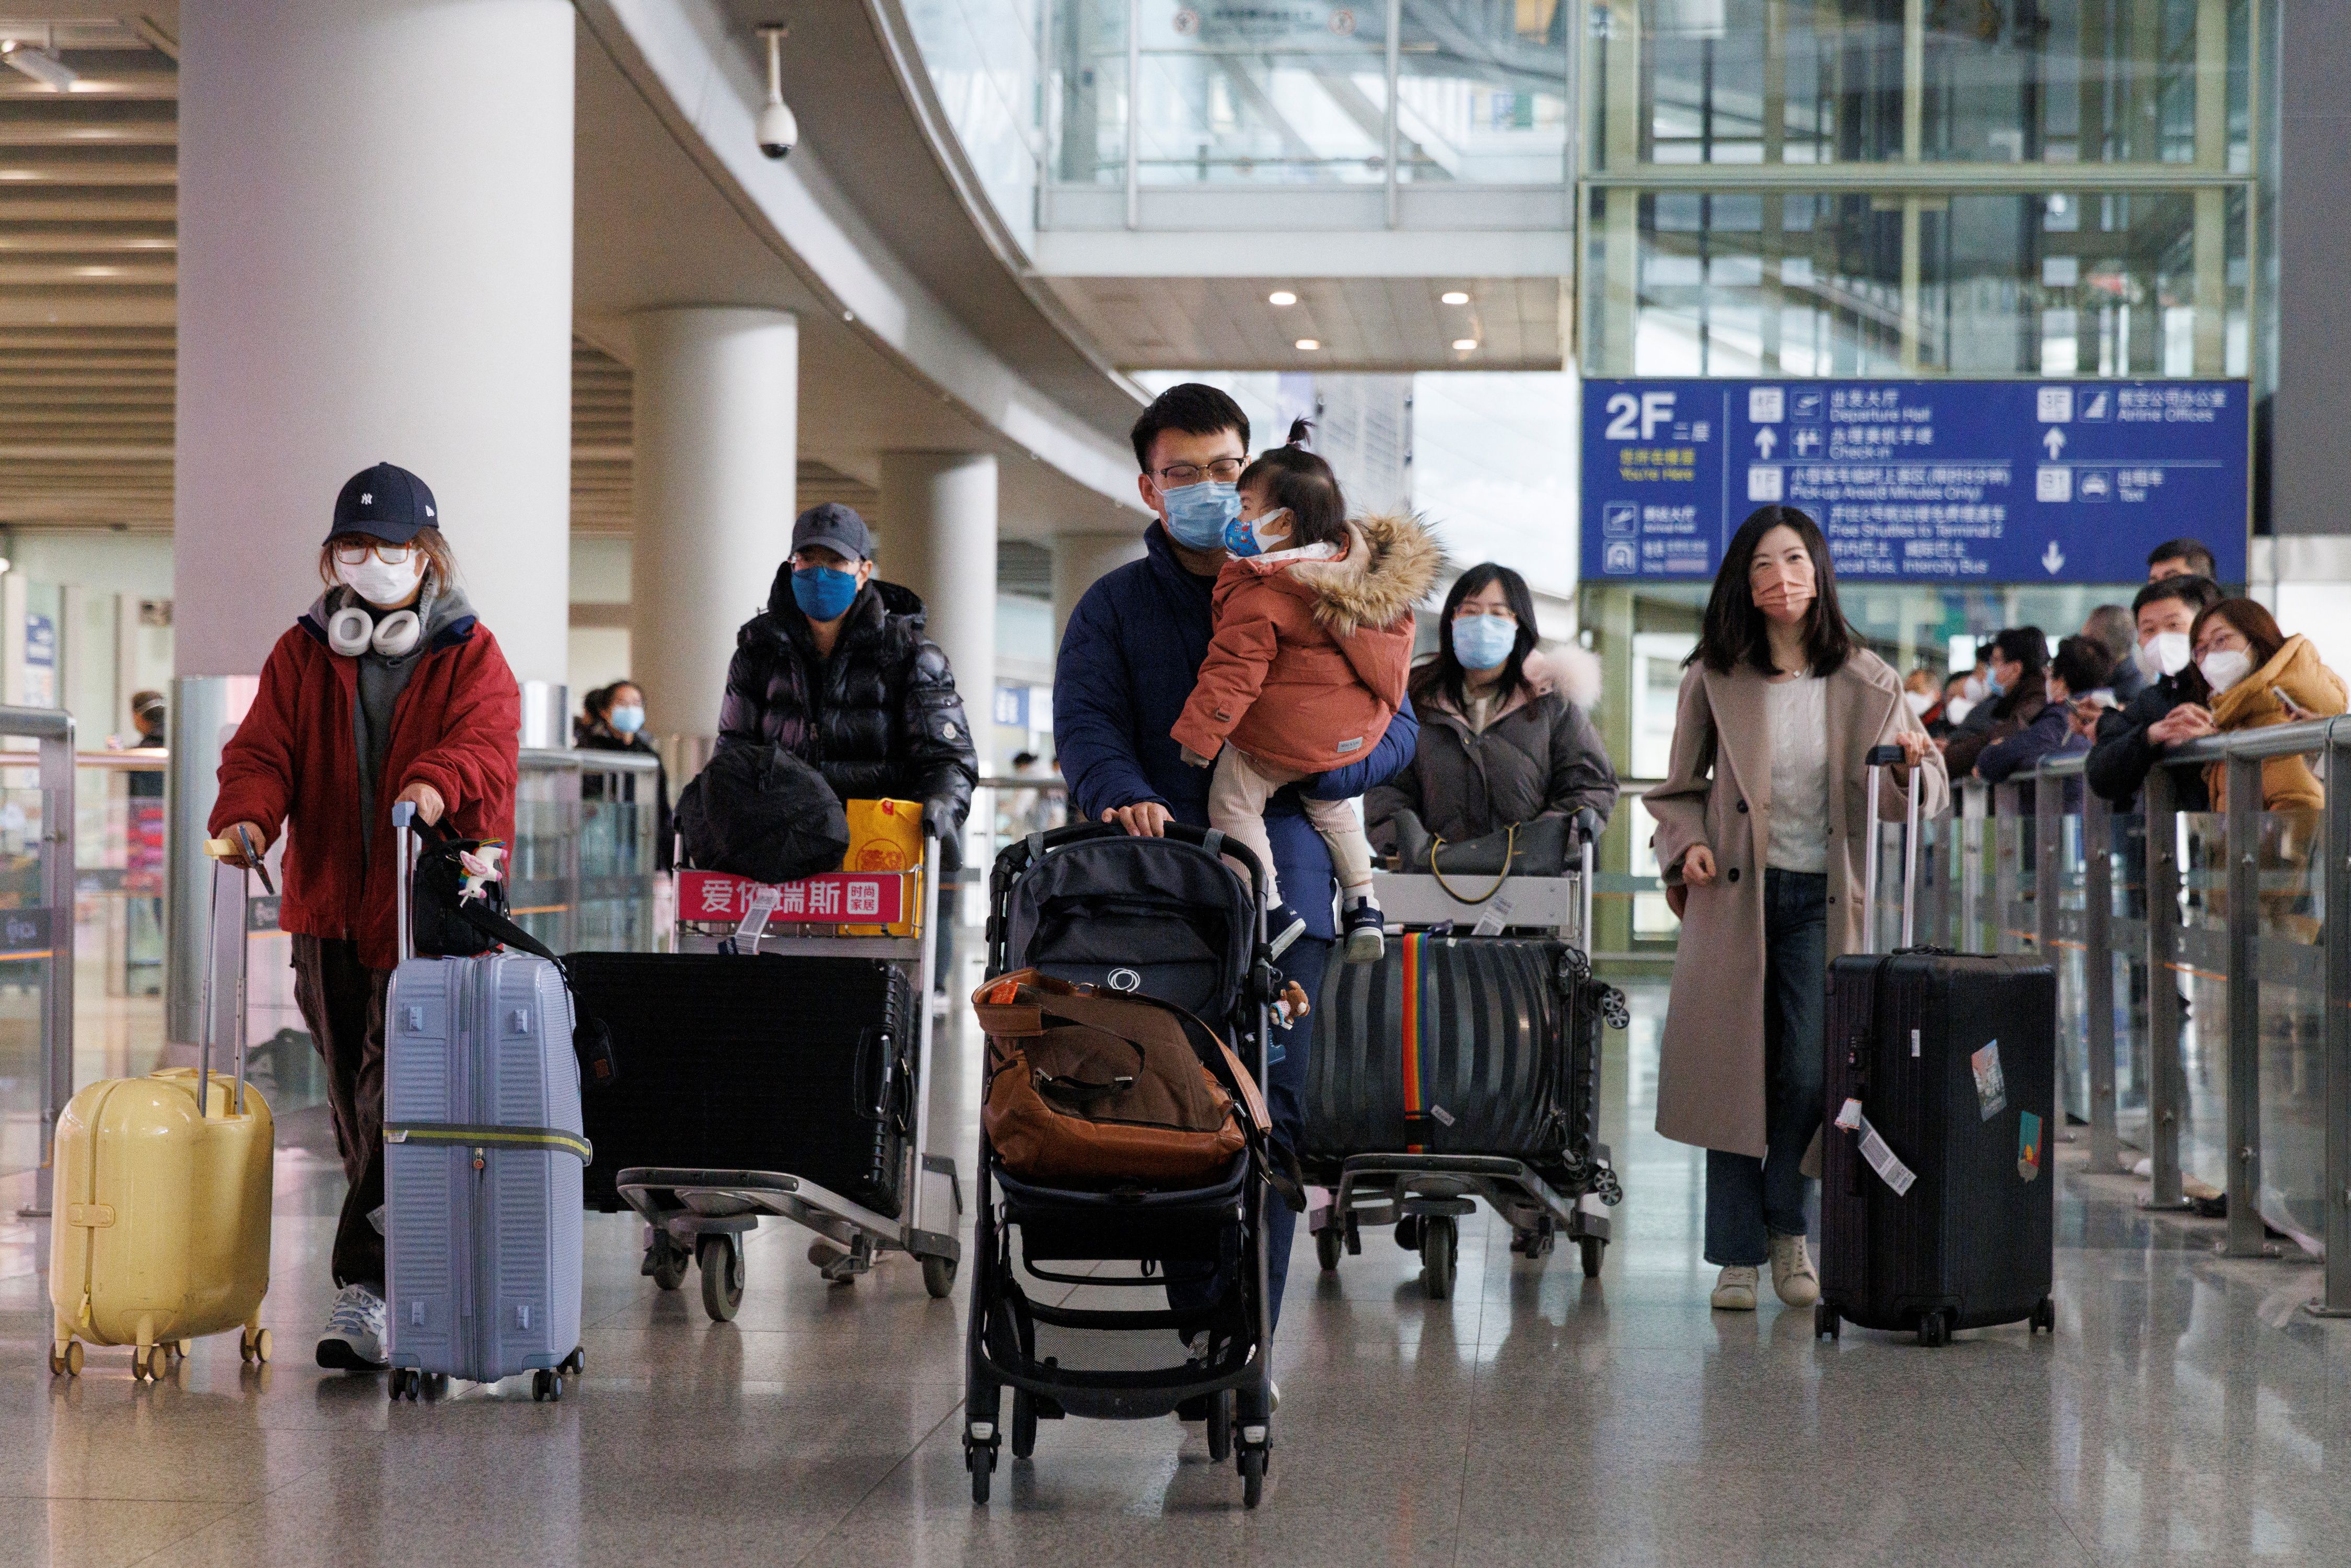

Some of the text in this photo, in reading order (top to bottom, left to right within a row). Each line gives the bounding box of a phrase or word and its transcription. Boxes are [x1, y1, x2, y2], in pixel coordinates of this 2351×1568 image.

[1605, 392, 1676, 440] 2F
[1830, 409, 1899, 423] Departure
[2117, 470, 2164, 487] 出租车
[361, 493, 373, 505] NY
[1829, 524, 1859, 538] Free
[1917, 524, 1933, 538] to
[1936, 524, 1991, 538] Terminal
[1992, 524, 2003, 538] 2
[1903, 560, 1958, 576] Intercity
[1960, 560, 1987, 574] Bus
[851, 886, 875, 898] 时尚
[851, 898, 875, 911] 家居
